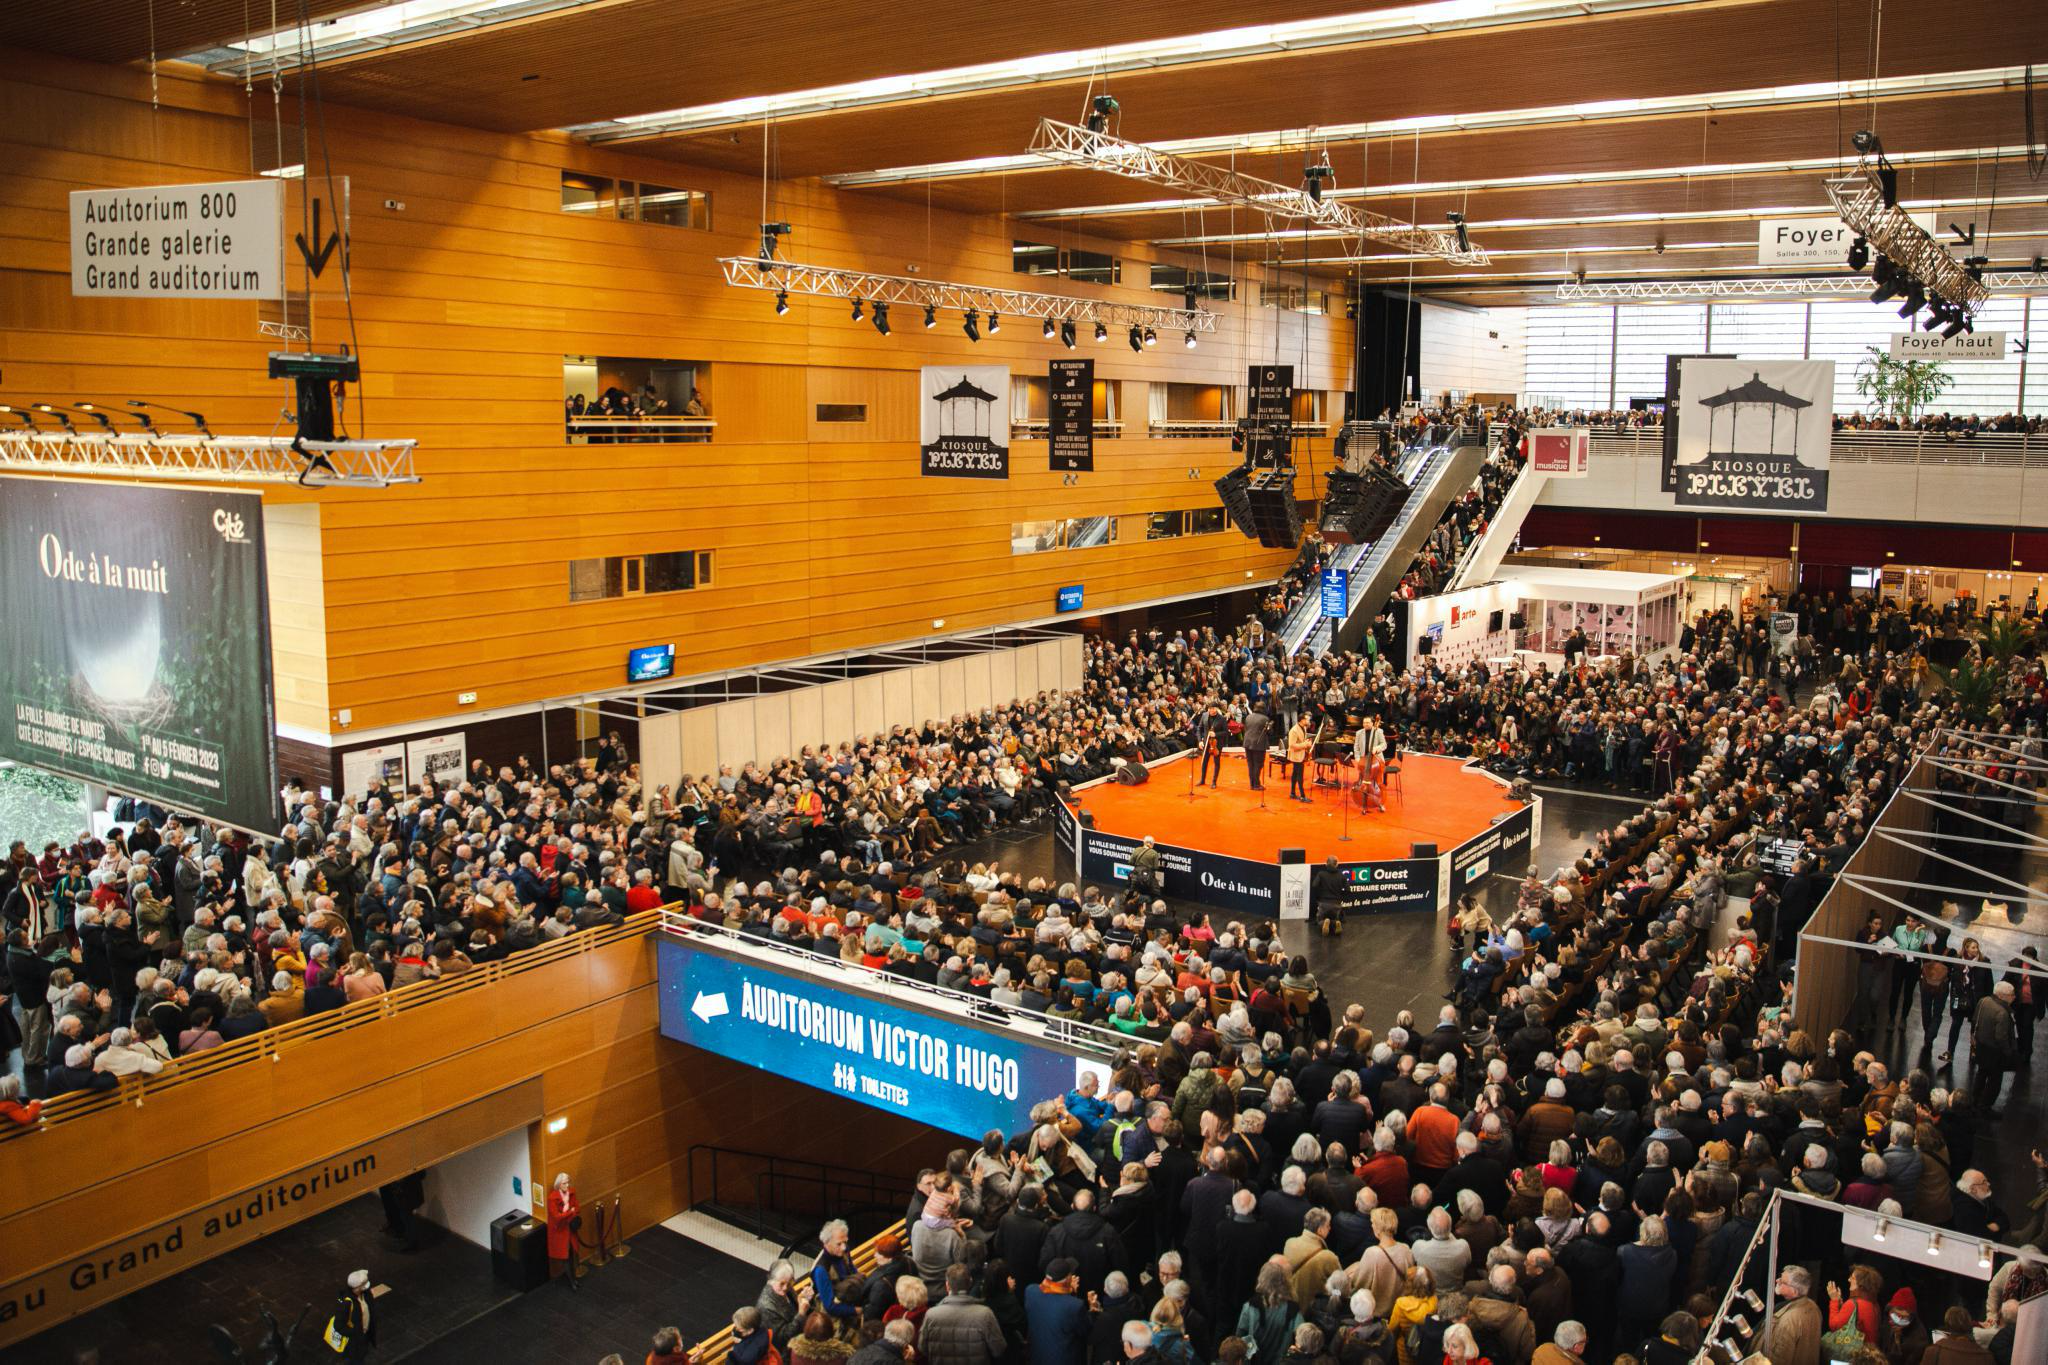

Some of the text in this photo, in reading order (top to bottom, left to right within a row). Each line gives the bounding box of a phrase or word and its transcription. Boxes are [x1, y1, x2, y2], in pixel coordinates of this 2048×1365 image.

[85, 192, 237, 224] Auditorium 800
[85, 228, 232, 261] Grande galerie
[1777, 226, 1845, 246] Foyer
[86, 264, 260, 291] Grand auditorium
[1901, 335, 1993, 349] Foyer haut
[928, 451, 1002, 470] PLEYEL
[941, 441, 988, 453] KIOSQUE
[1536, 463, 1568, 471] musique
[1712, 460, 1792, 475] KIOSQUE
[1687, 473, 1815, 500] PLEYEL
[39, 533, 170, 595] Ode à la nuit
[16, 703, 26, 720] LA
[70, 717, 80, 734] DE
[80, 719, 106, 742] NANTES
[78, 739, 103, 761] ESPACE
[114, 748, 136, 770] OUEST
[152, 737, 162, 756] AU
[162, 739, 169, 758] 5
[199, 748, 220, 772] 2023
[1089, 838, 1096, 846] LA
[1096, 840, 1109, 849] VILLE
[1109, 842, 1116, 850] DE
[1089, 846, 1131, 861] VOUS SOUHAITEN
[1162, 852, 1192, 865] MÉTROPOLE
[1201, 871, 1272, 899] Ode à la nuit
[1374, 868, 1409, 880] Ouest
[1380, 883, 1408, 892] OFFICIEL
[742, 981, 1019, 1100] AUDITORIUM VICTOR HUGO
[861, 1074, 909, 1107] TOILETTES
[0, 1155, 377, 1323] au Grand auditorium
